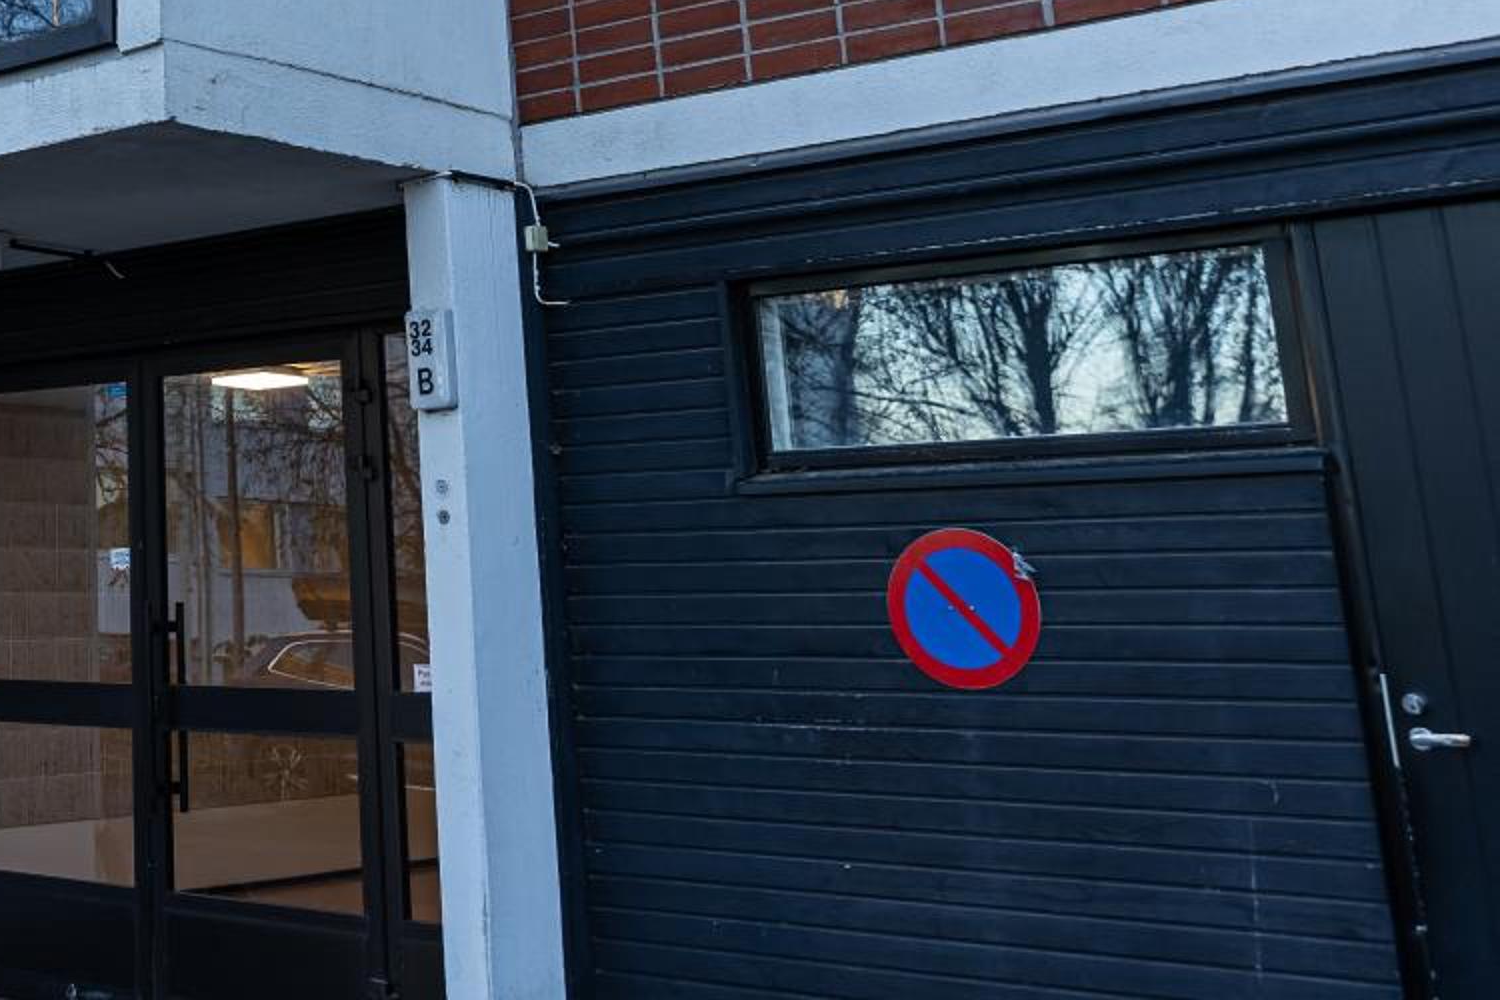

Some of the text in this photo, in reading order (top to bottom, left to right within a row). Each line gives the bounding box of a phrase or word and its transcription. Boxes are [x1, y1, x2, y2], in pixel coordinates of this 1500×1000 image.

[409, 319, 432, 338] 32
[411, 339, 433, 356] 34
[417, 368, 435, 395] B
